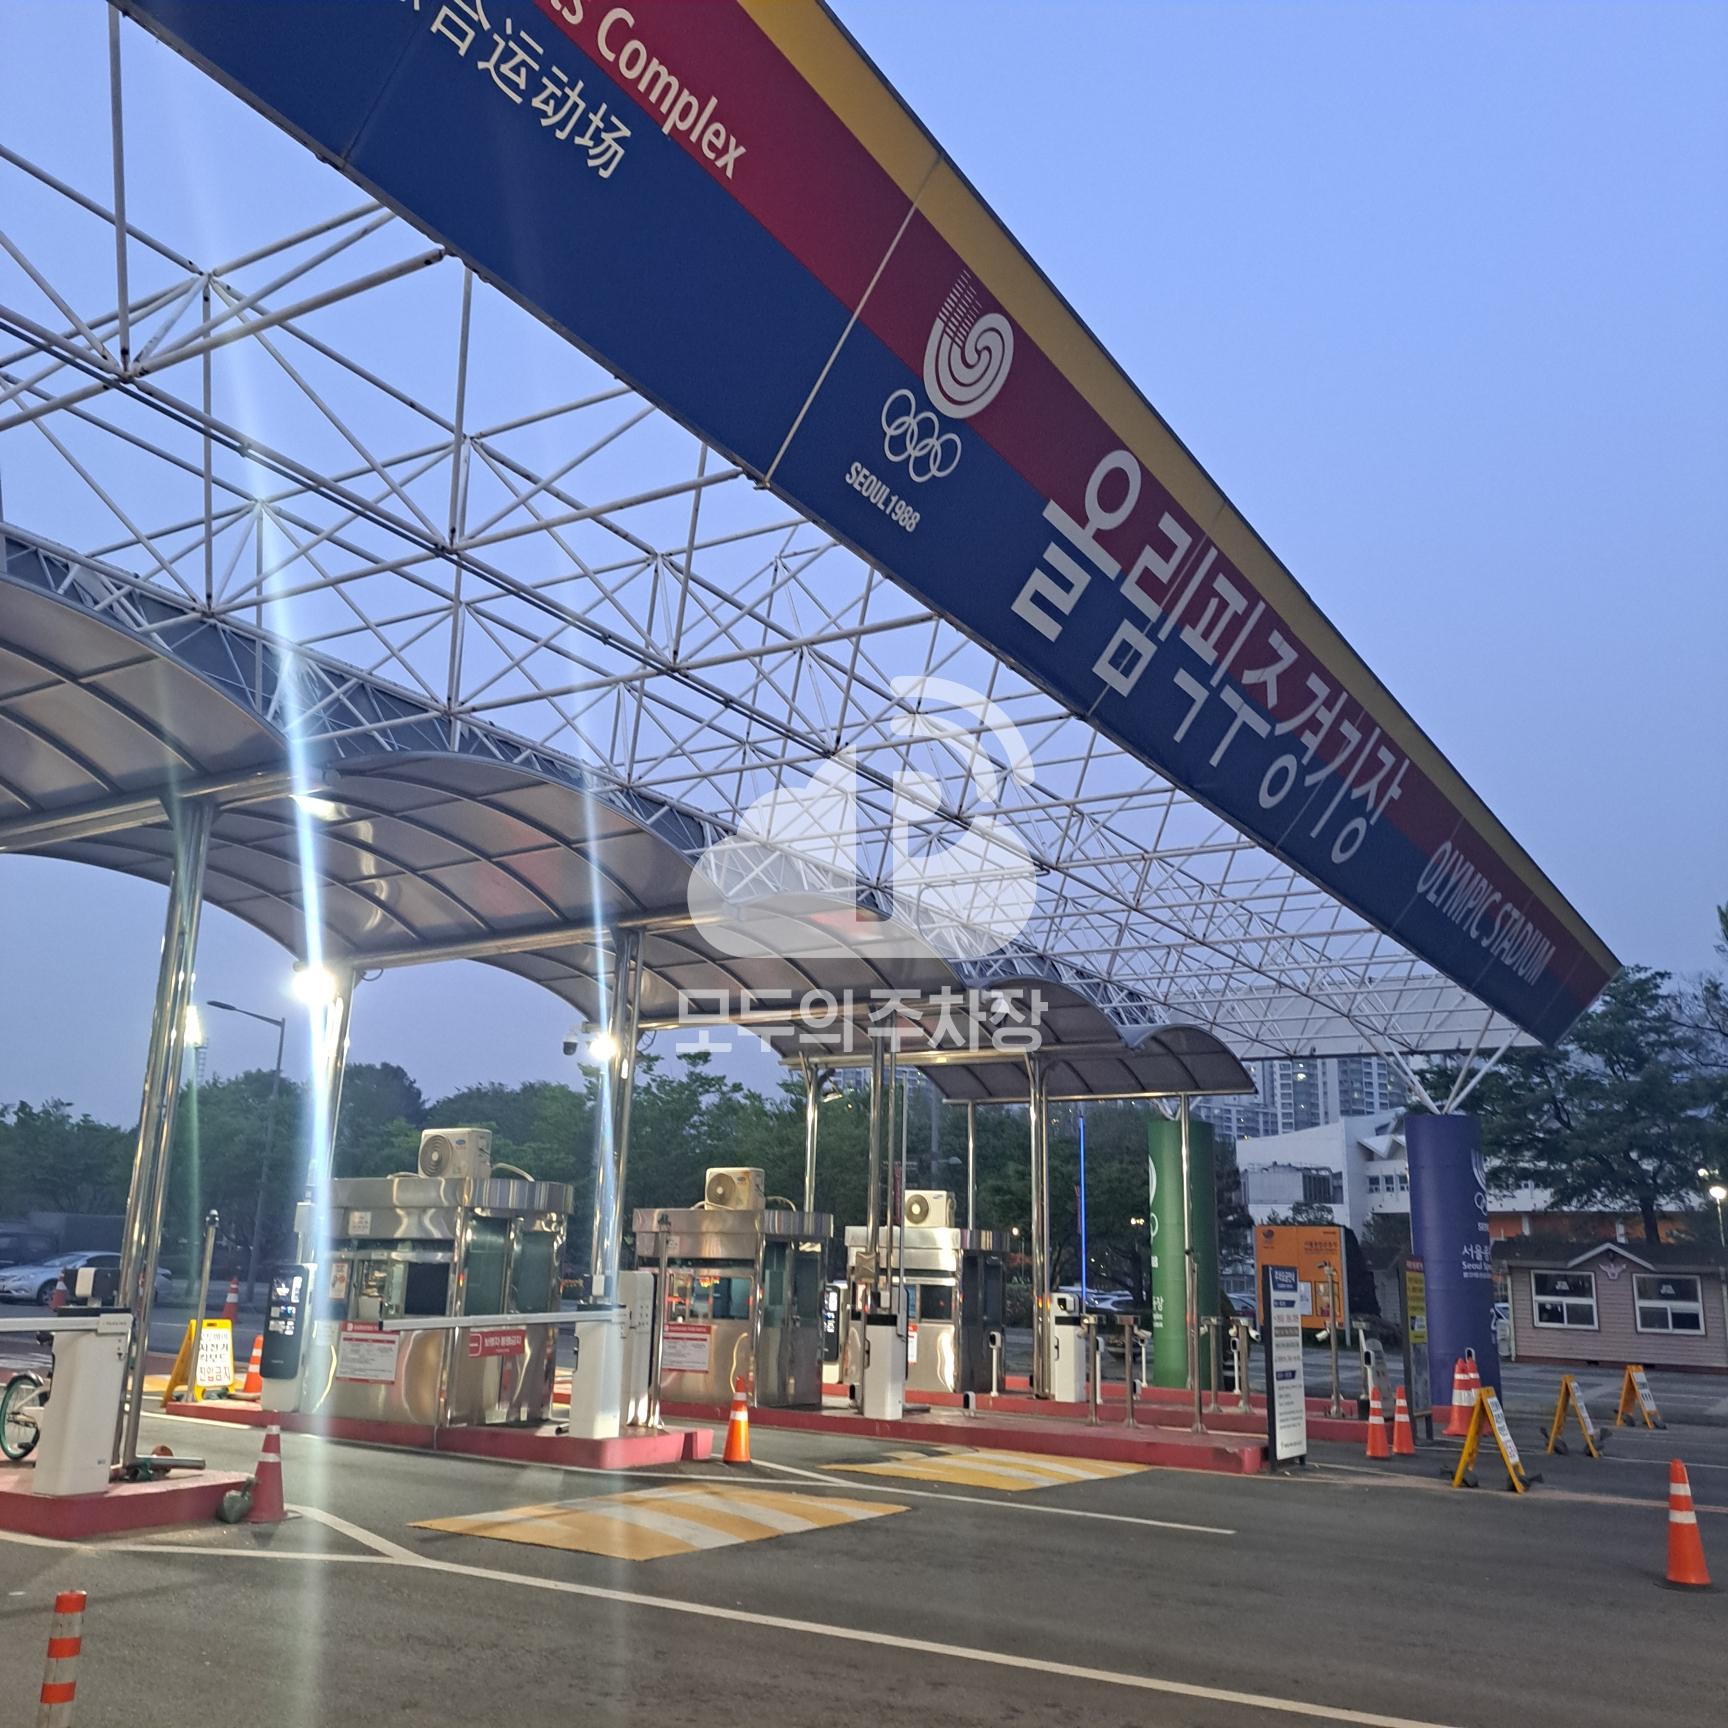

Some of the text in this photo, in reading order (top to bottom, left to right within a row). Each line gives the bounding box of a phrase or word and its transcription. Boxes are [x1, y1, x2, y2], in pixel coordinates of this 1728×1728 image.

[597, 8, 747, 180] Complex
[1010, 449, 1411, 864] 올림픽주경기장
[1416, 841, 1556, 987] OLYMPIC STADIUM
[1461, 1261, 1483, 1270] Seoul
[199, 1366, 231, 1382] 진입금지
